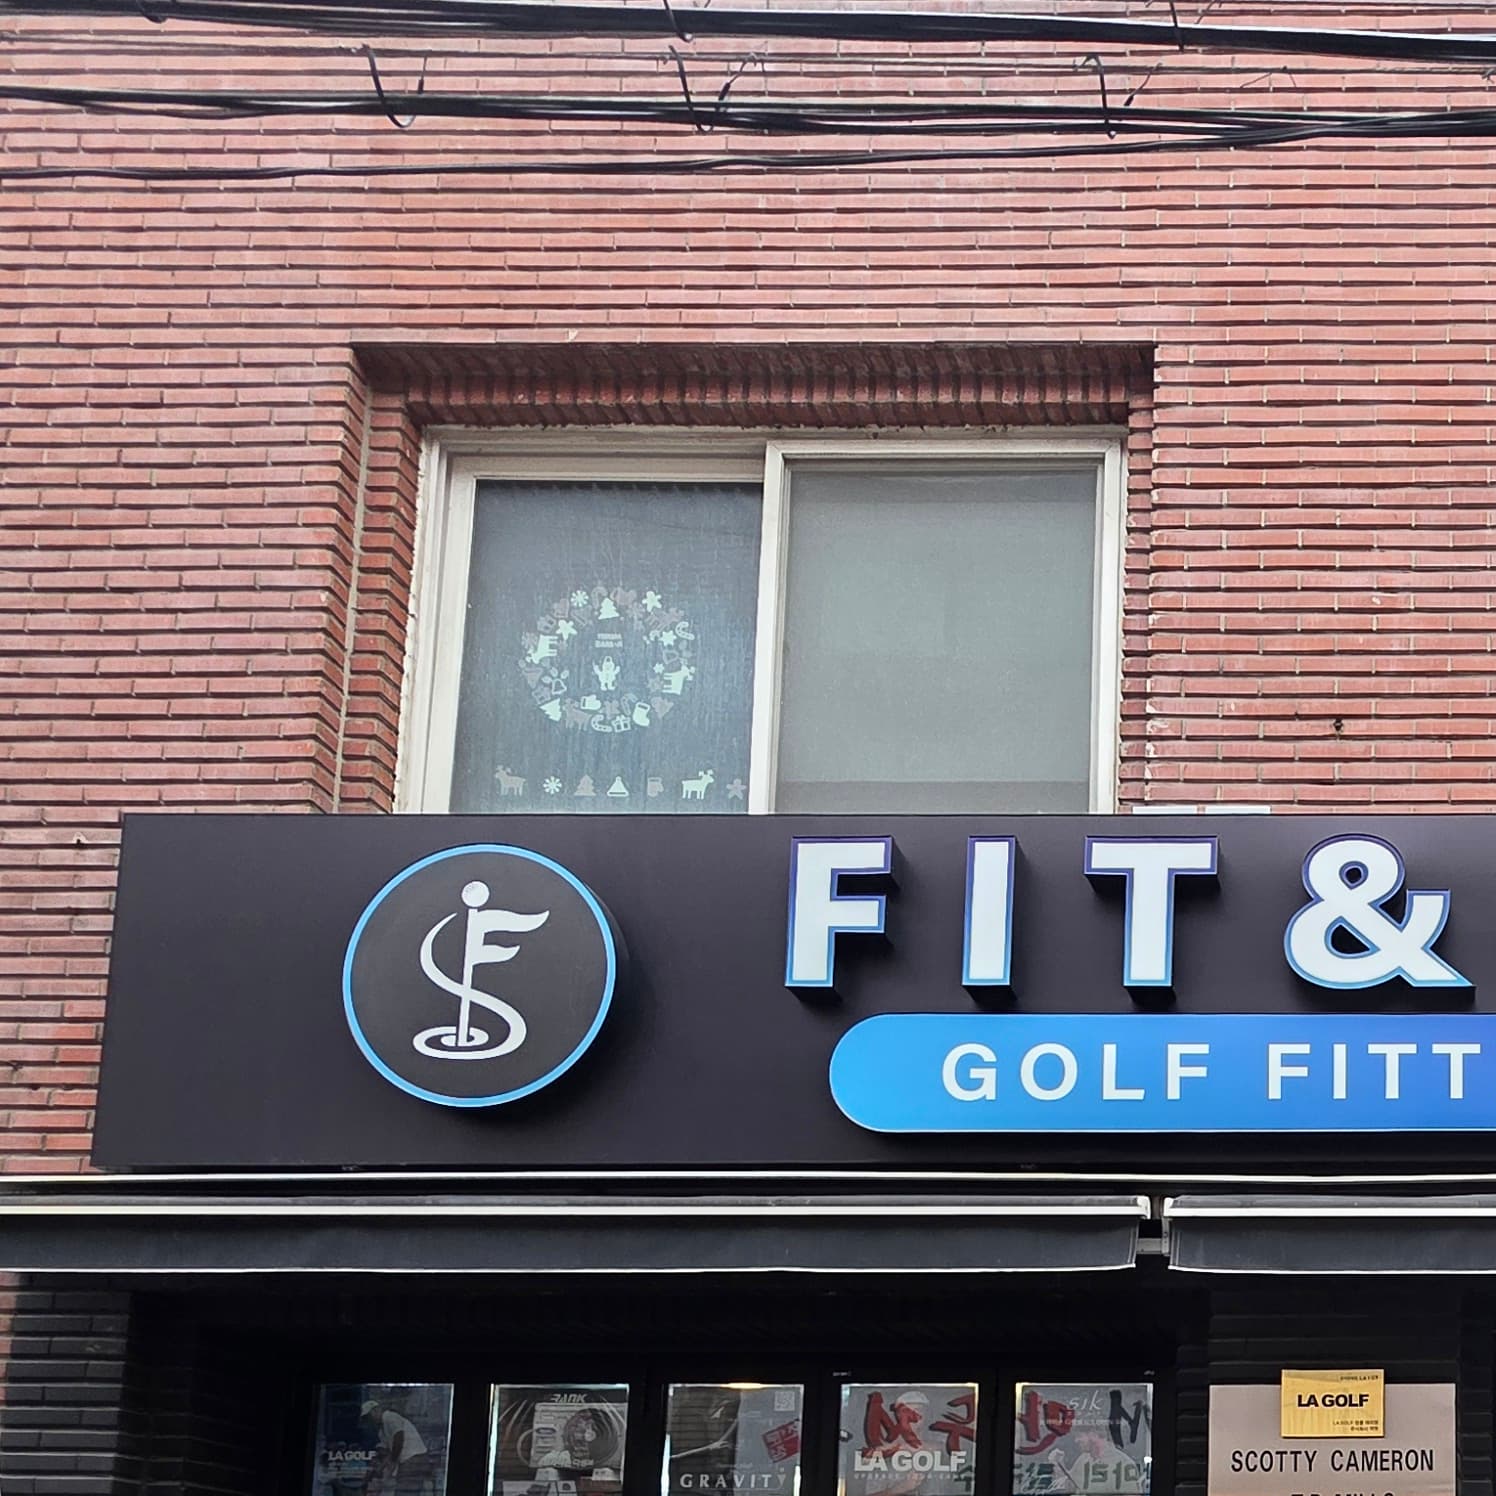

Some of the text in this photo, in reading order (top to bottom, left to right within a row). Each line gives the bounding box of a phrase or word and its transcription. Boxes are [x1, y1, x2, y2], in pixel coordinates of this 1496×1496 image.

[942, 1044, 1208, 1101] GOLF
[1298, 1394, 1369, 1407] LA GOLF
[854, 1451, 967, 1472] LA GOLF
[1231, 1450, 1434, 1472] SCOTTY CAMERON
